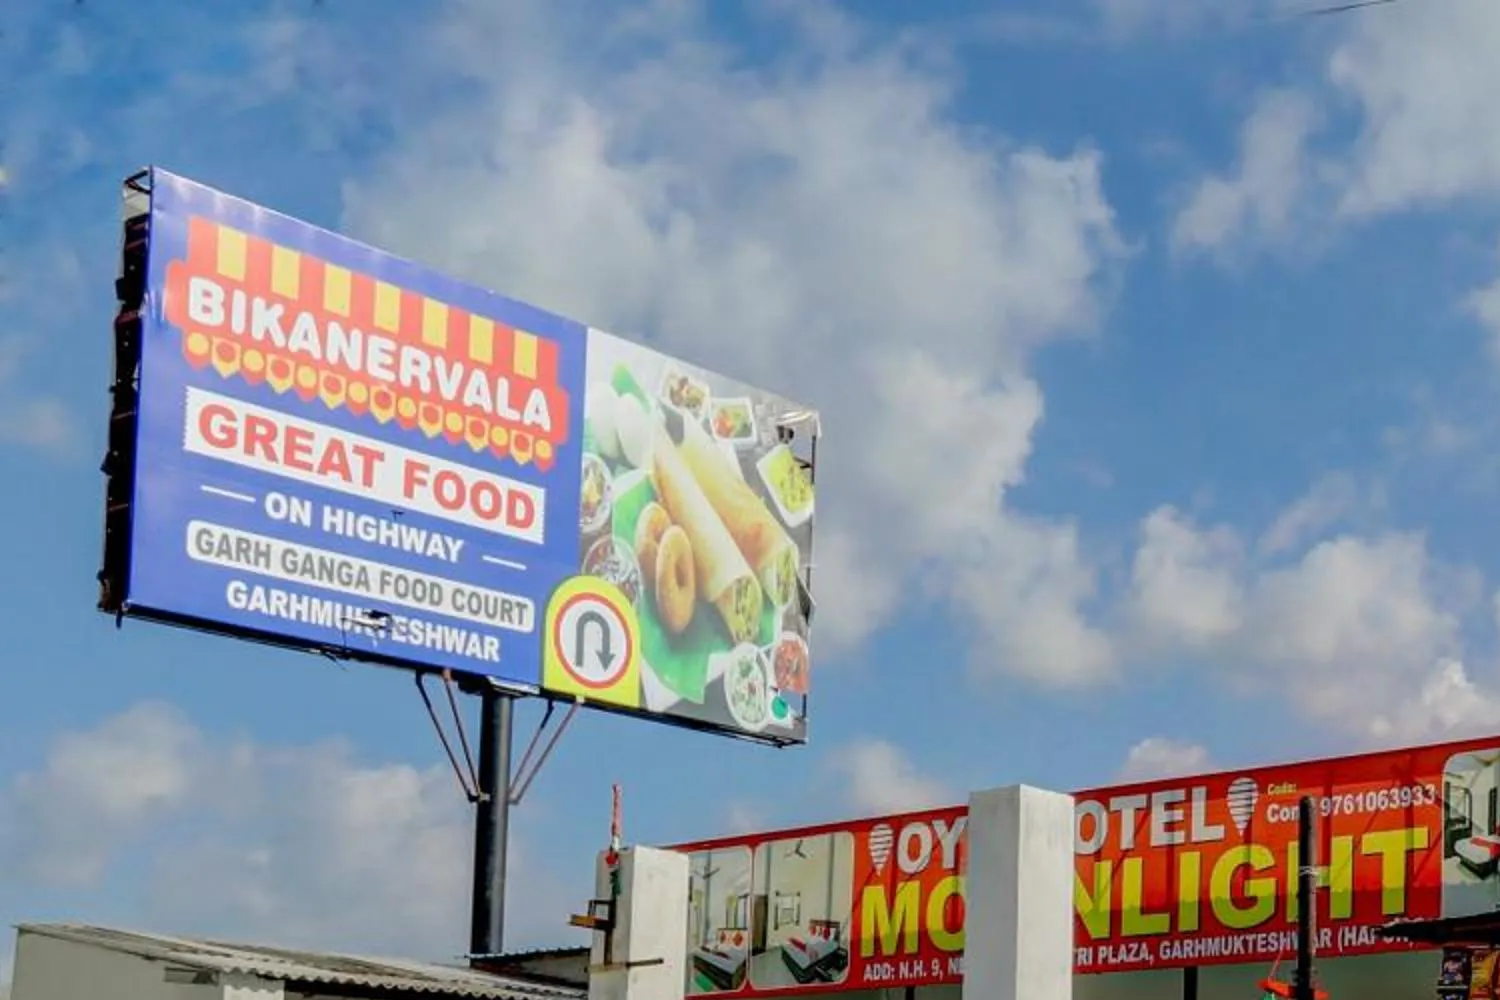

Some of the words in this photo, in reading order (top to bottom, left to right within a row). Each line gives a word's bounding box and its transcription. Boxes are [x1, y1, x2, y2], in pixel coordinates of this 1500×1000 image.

[187, 276, 551, 432] BIKANERVALA
[198, 403, 385, 489] GREAT
[403, 458, 536, 530] FOOD
[265, 492, 313, 528] ON
[322, 505, 465, 563] HIGHWAY
[194, 527, 272, 570] GARH
[280, 547, 372, 592] GANGA
[379, 571, 443, 607] FOOD
[450, 586, 529, 626] COURT
[1074, 786, 1226, 855] OTEL
[1320, 783, 1437, 817] 9761063933
[861, 826, 1430, 958] MONLIGHT
[863, 963, 896, 982] ADD:
[900, 961, 927, 979] N.H.
[1097, 941, 1154, 965] PLAZA,
